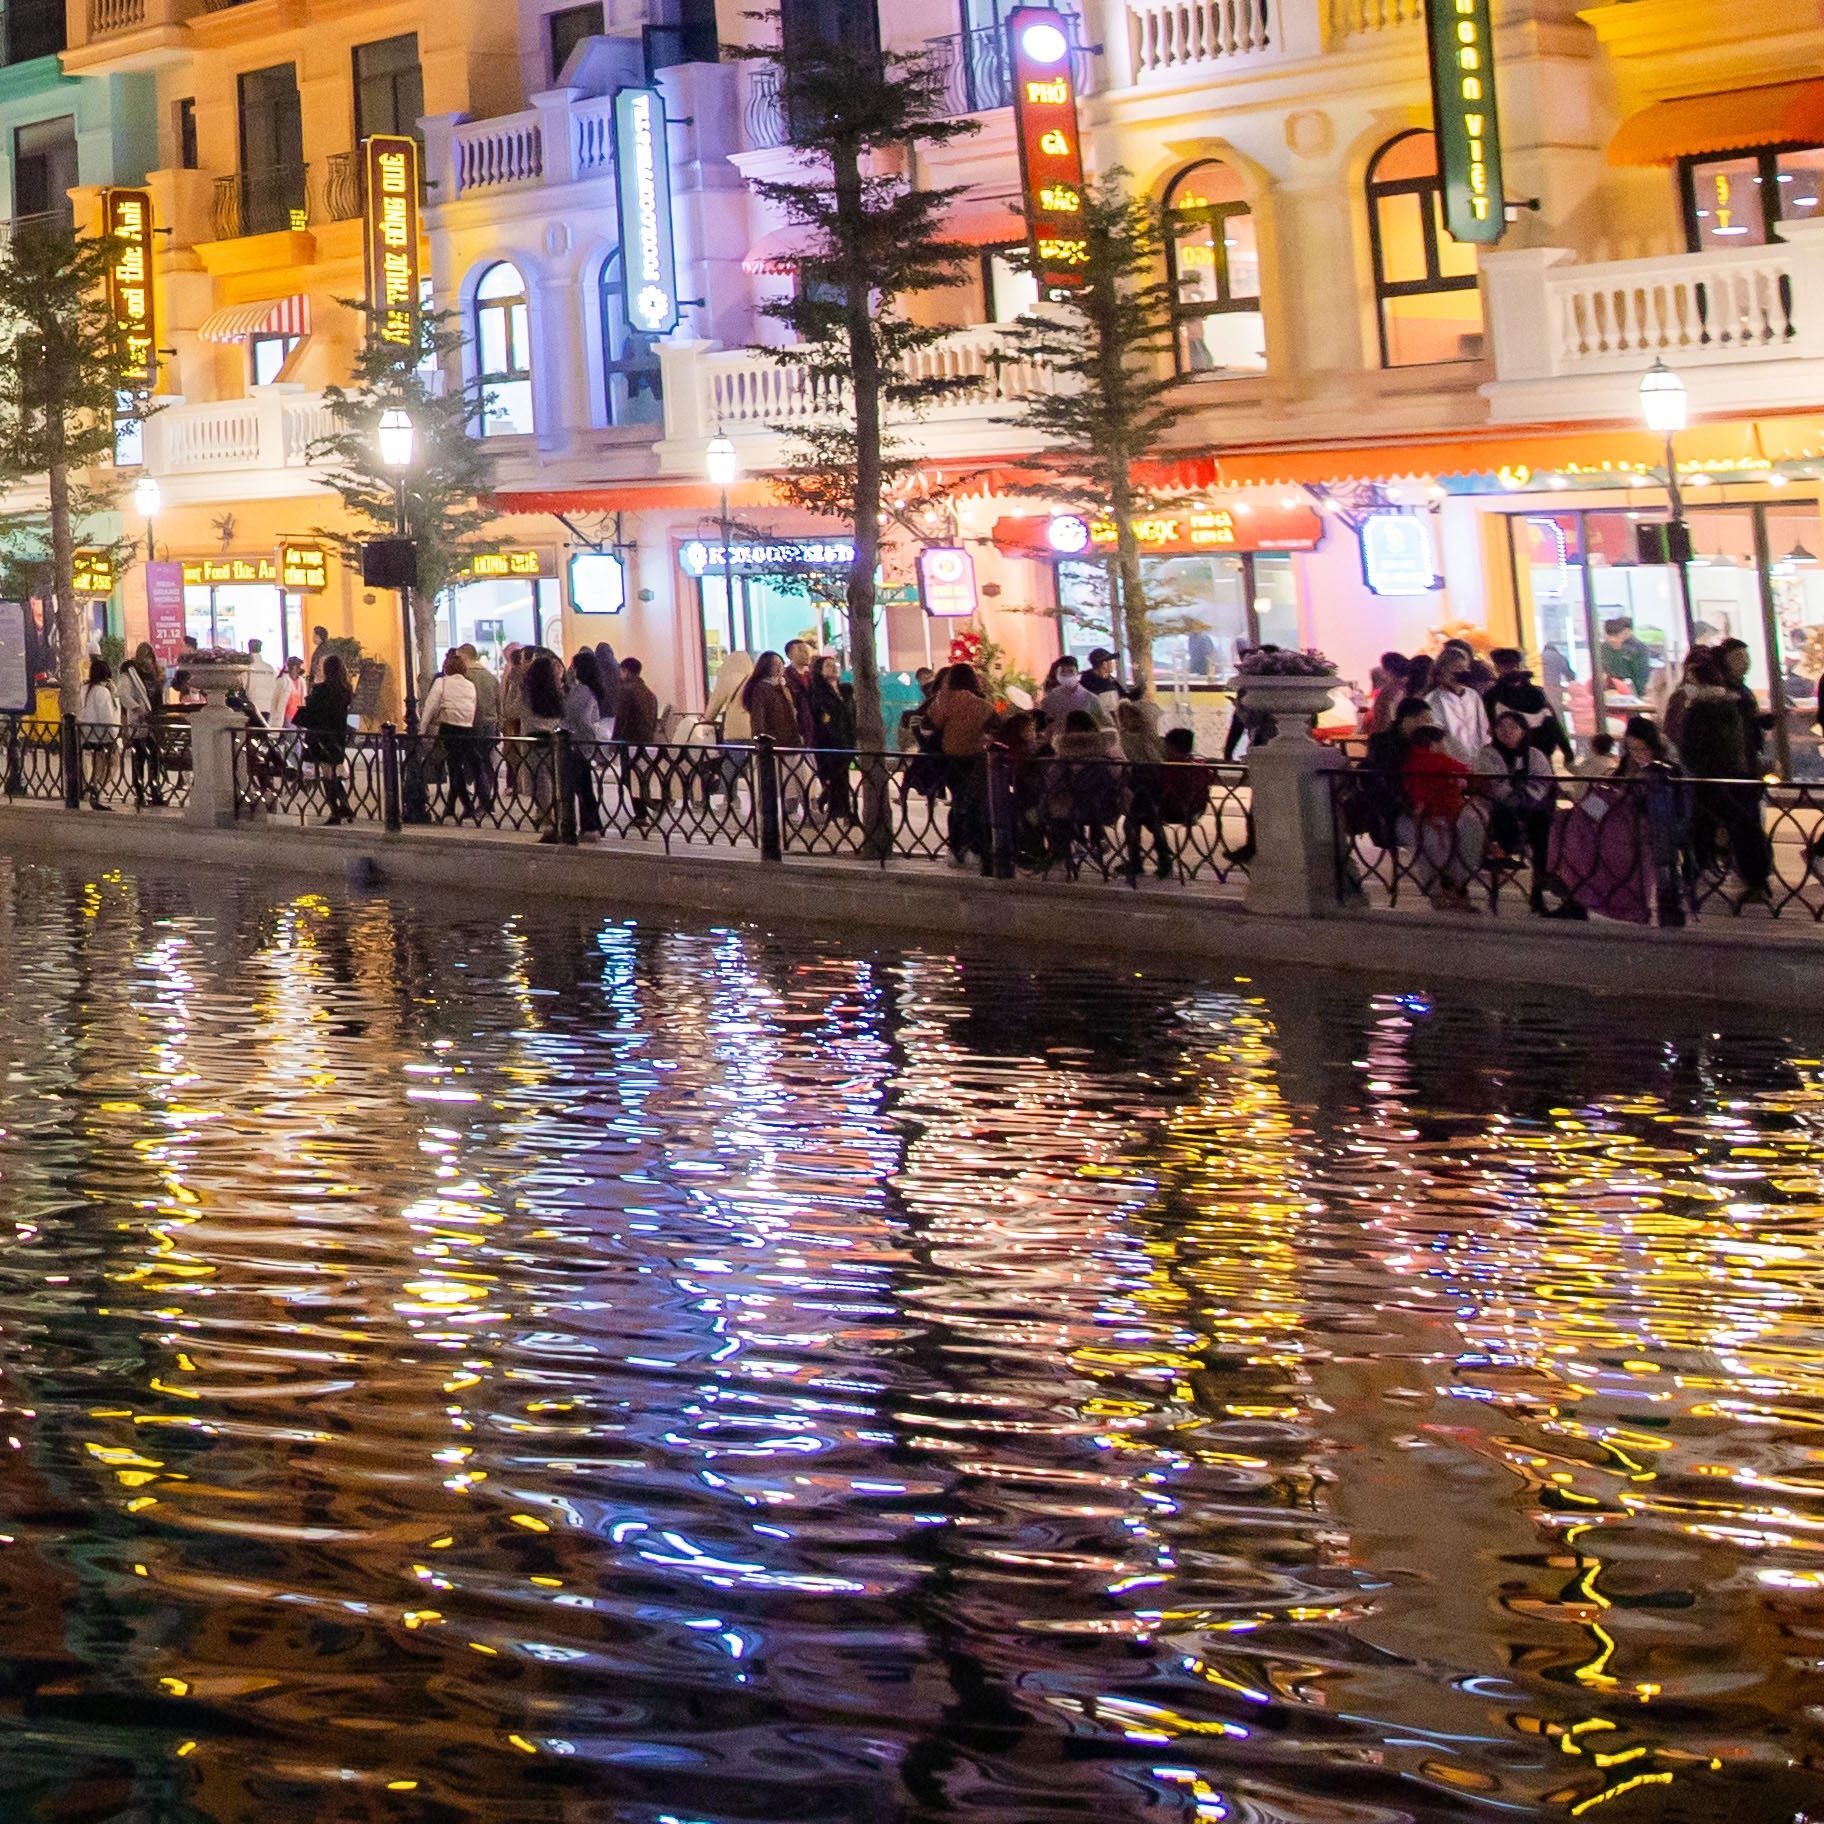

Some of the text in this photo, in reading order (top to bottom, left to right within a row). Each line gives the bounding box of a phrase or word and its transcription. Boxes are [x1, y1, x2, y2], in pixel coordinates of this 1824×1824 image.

[1026, 76, 1067, 104] PHỞ
[1041, 129, 1069, 155] GÀ
[378, 152, 406, 193] QUÊ
[204, 561, 230, 580] Food
[259, 560, 277, 579] An
[157, 629, 180, 639] 21.12
